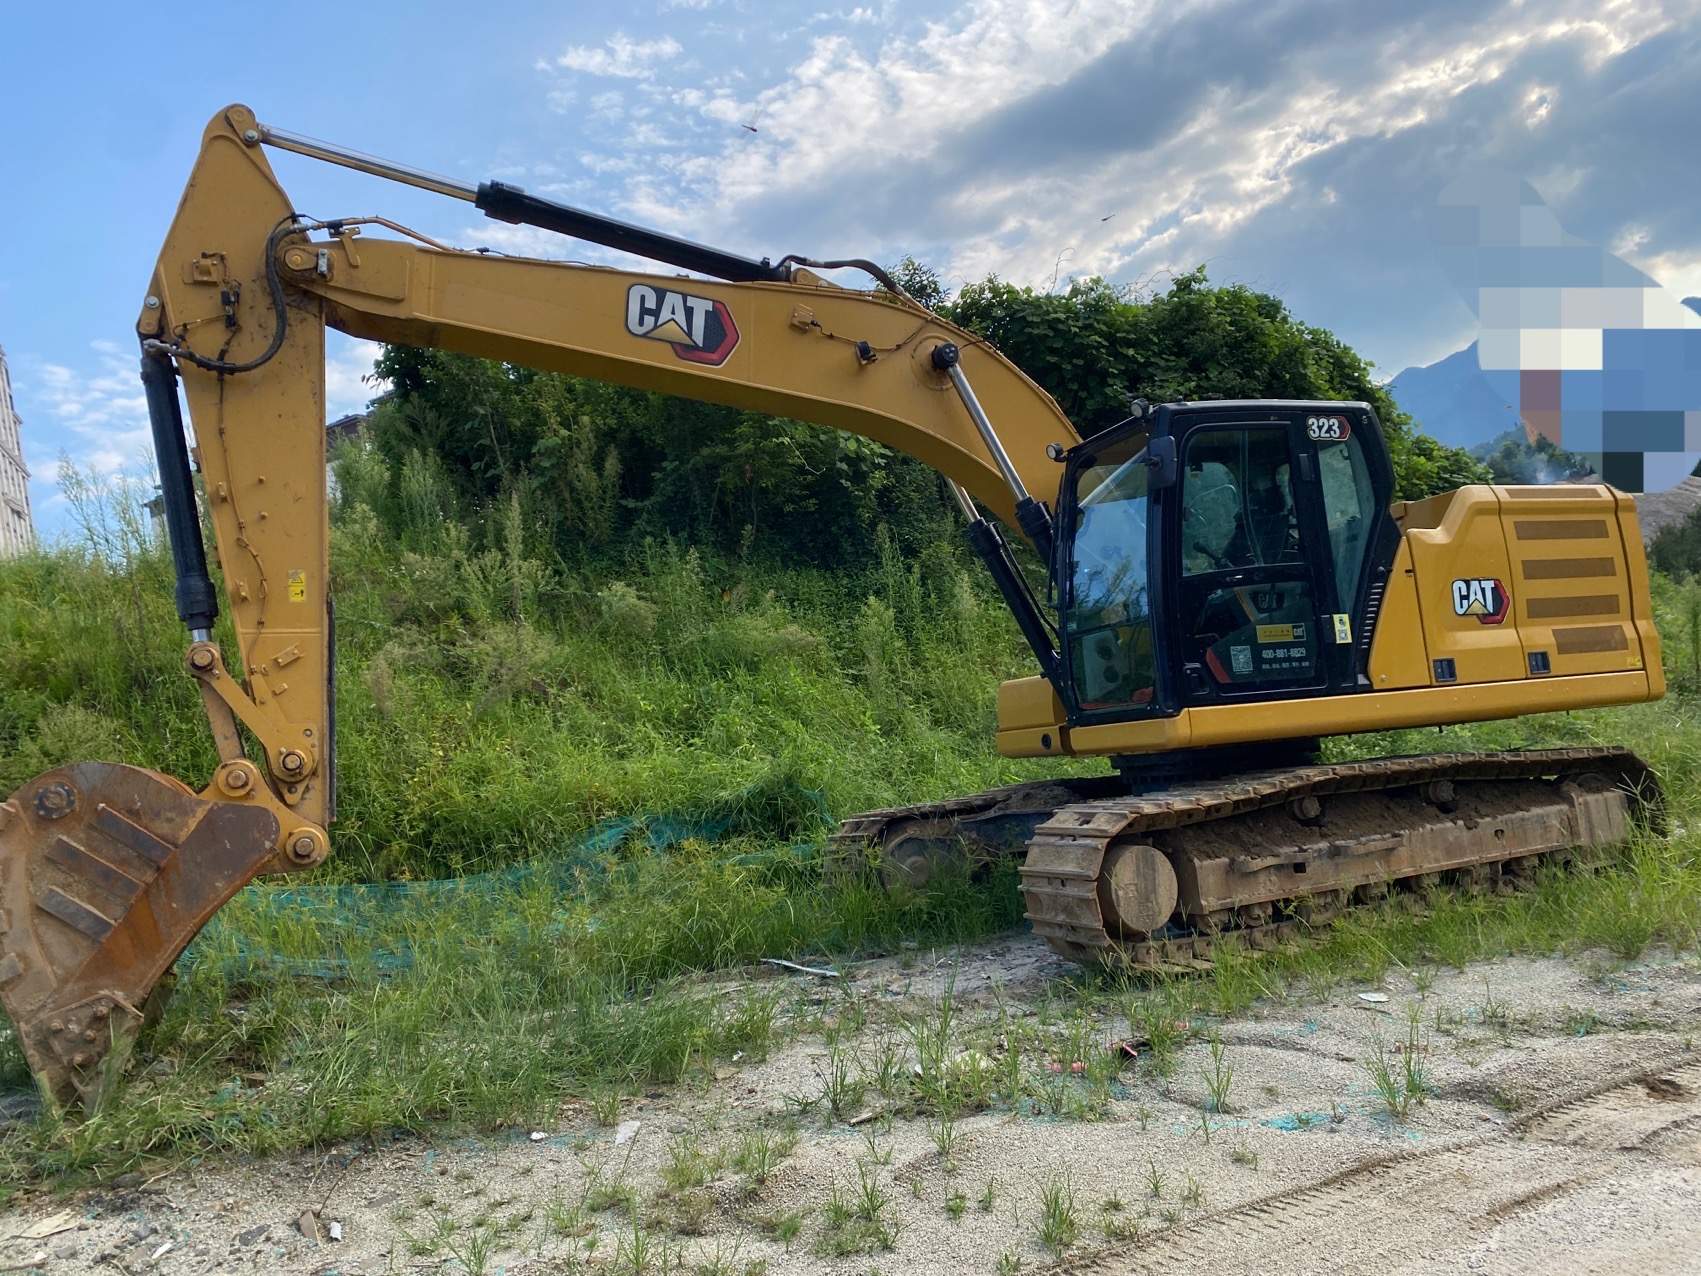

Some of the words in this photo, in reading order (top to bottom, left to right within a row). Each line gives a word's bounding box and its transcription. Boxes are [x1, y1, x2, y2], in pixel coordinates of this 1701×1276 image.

[627, 284, 713, 348] CAT
[1308, 417, 1340, 438] 323
[1452, 580, 1495, 615] CAT
